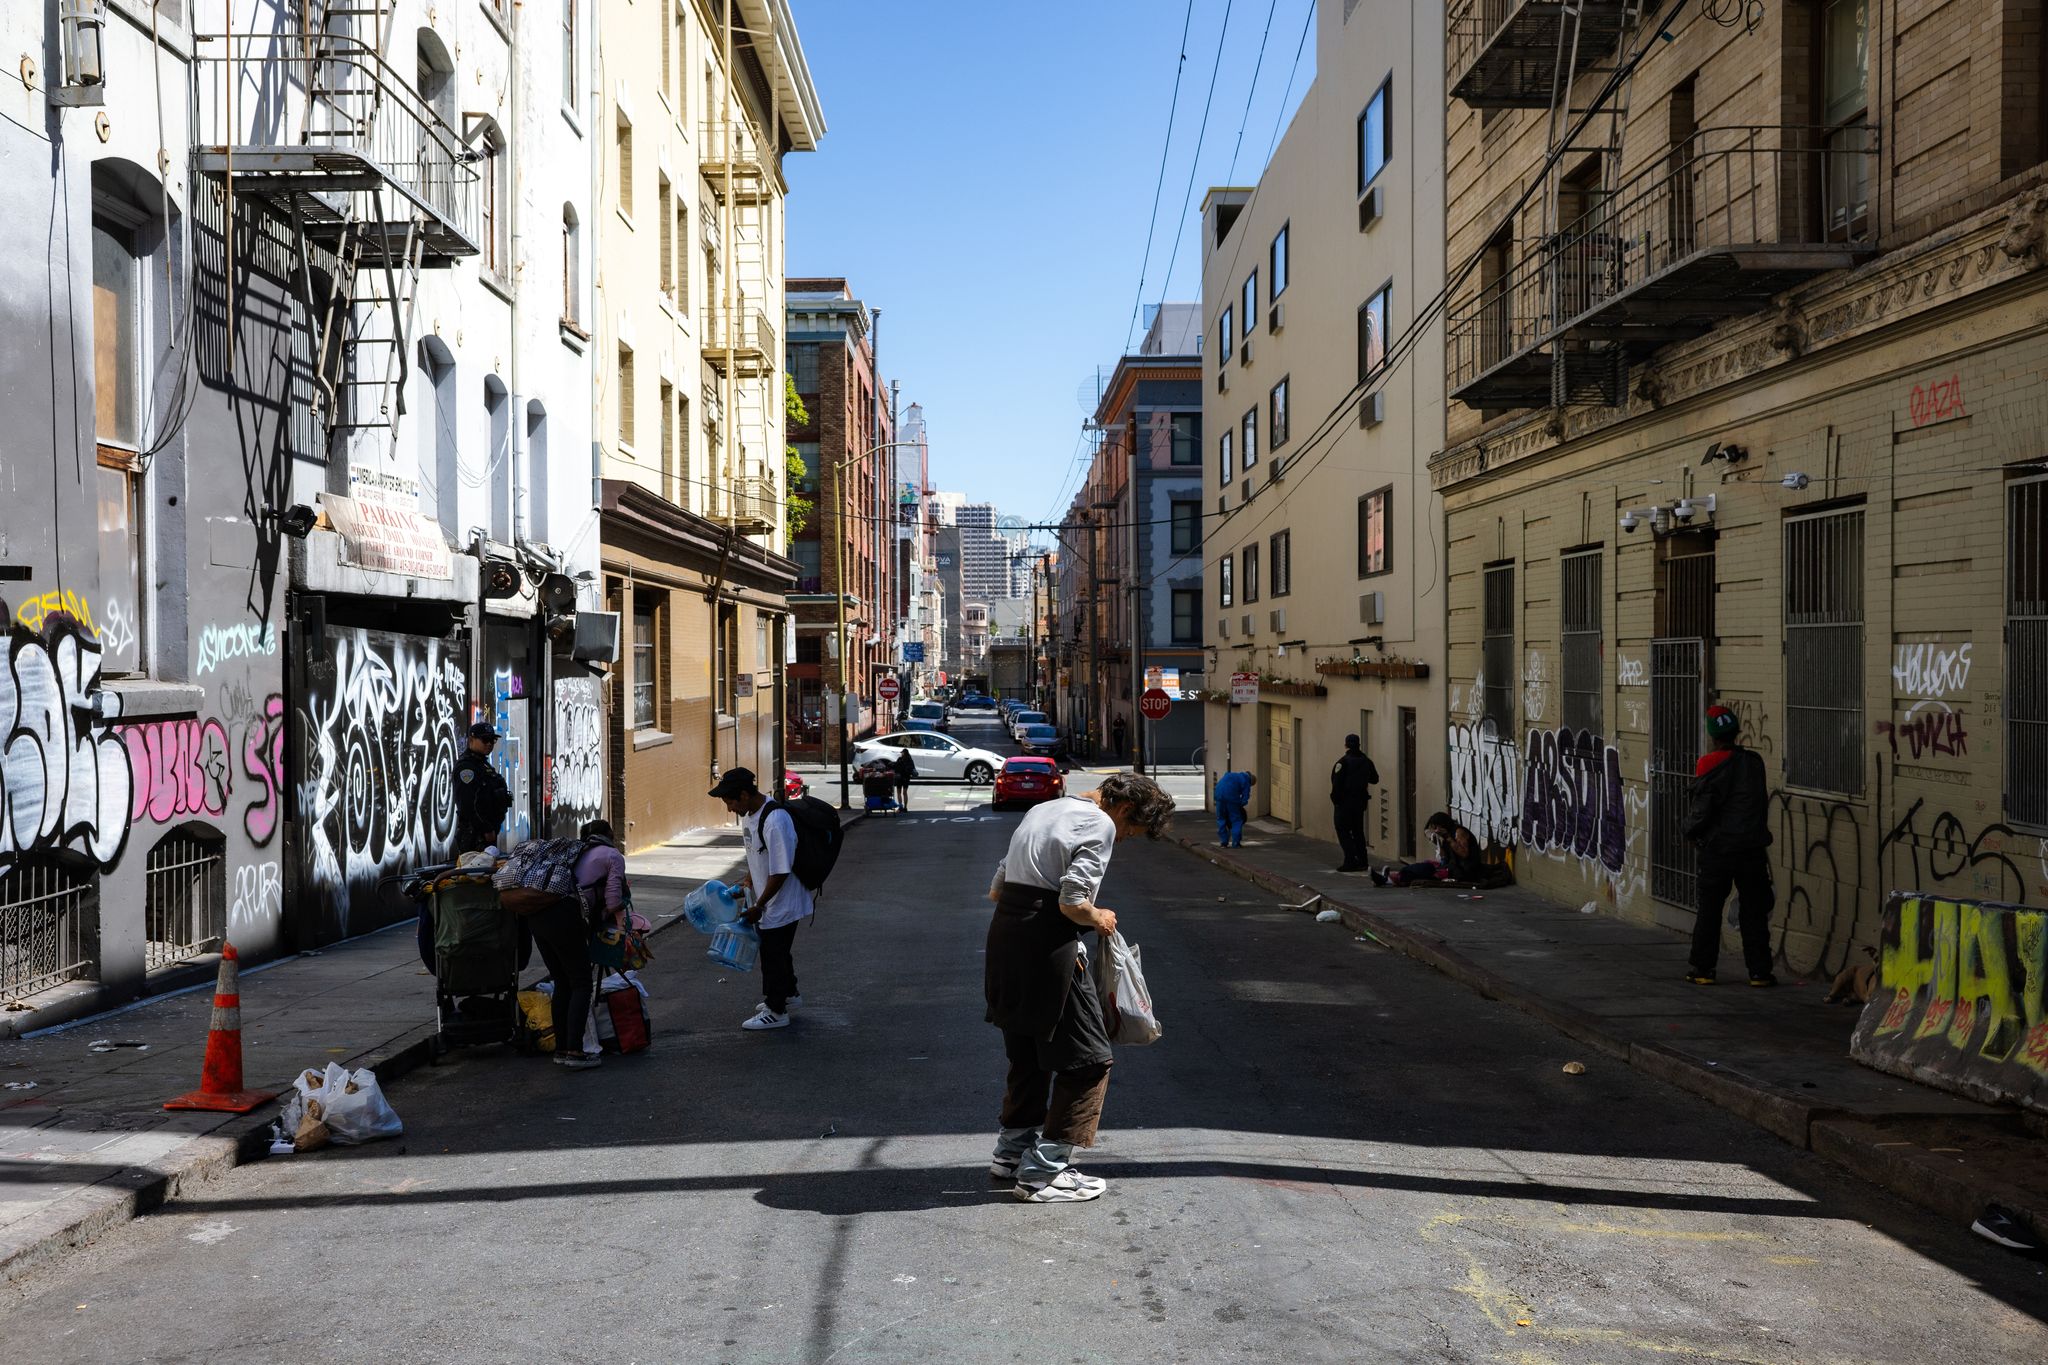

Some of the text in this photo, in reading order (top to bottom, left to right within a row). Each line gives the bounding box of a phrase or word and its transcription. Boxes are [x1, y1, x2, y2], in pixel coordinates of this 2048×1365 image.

[360, 502, 419, 533] PARKING
[350, 523, 381, 540] HOURLY
[1142, 698, 1169, 712] STOP
[896, 816, 1003, 825] STOP
